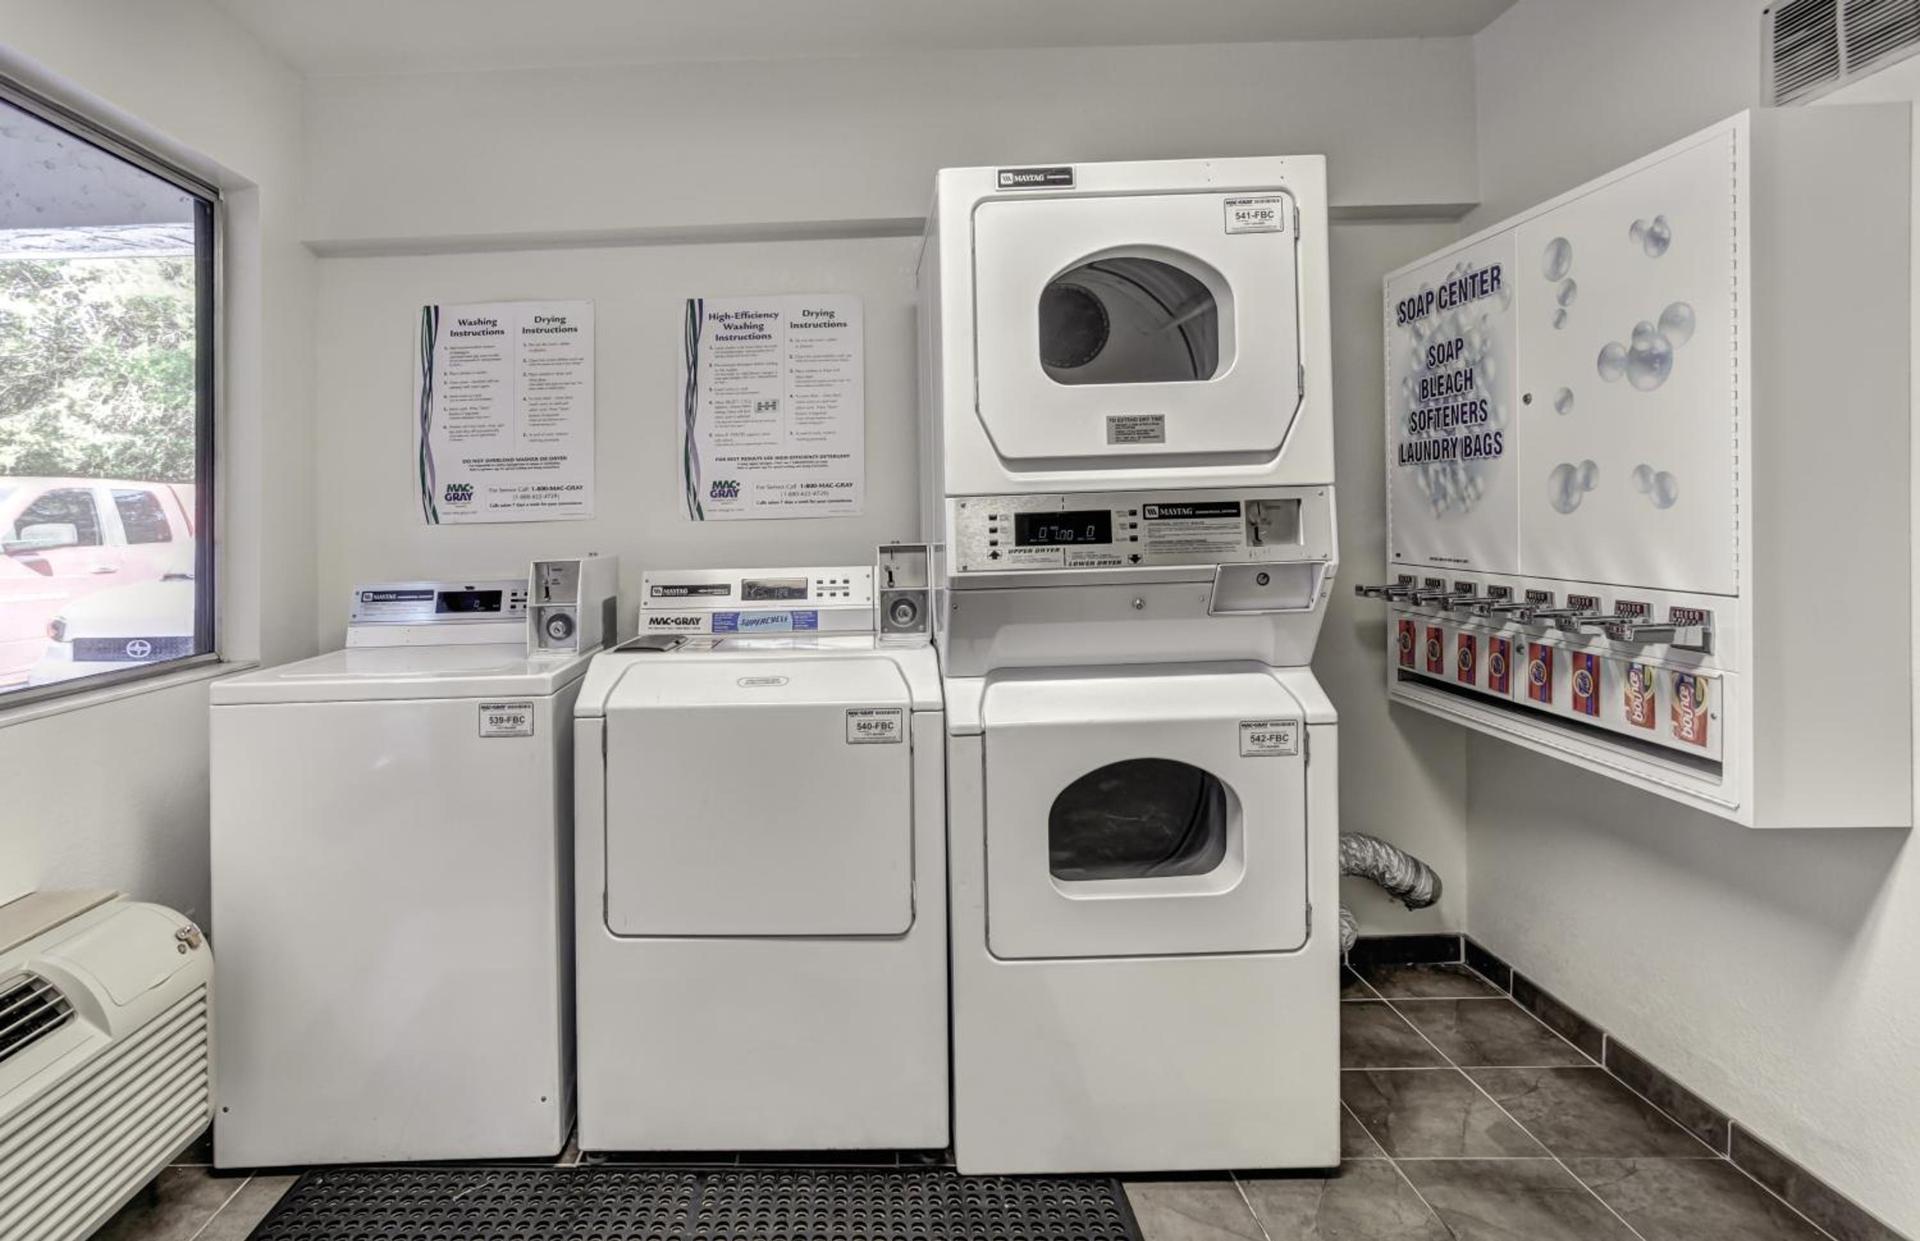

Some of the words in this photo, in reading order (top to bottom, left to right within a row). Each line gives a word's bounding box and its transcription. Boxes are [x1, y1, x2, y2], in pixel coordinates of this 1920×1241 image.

[1015, 174, 1044, 182] MAYTAG
[1235, 210, 1274, 220] 541-FBC
[1398, 290, 1435, 323] SOAP
[1438, 265, 1501, 309] CENTER
[708, 311, 779, 321] High-Efficiency
[802, 309, 835, 319] Drying
[458, 318, 497, 328] Washing
[534, 315, 567, 325] Drying
[522, 326, 578, 335] Instructions
[723, 322, 764, 332] Washing
[790, 321, 847, 330] Instructions
[450, 328, 505, 338] Instructions
[715, 333, 772, 342] Instructions
[1428, 338, 1464, 367] SOAP
[1421, 368, 1473, 400] BLEACH
[1410, 399, 1488, 432] SOFTENERS
[1400, 437, 1458, 463] LAUNDRY
[1463, 431, 1503, 458] BAGS
[445, 492, 473, 501] GRAY
[710, 489, 740, 498] GRAY
[1160, 507, 1193, 515] MAYTAG
[489, 715, 525, 725] 539-FBC
[857, 722, 894, 731] 540-FBC
[1250, 734, 1288, 743] 542-FBC
